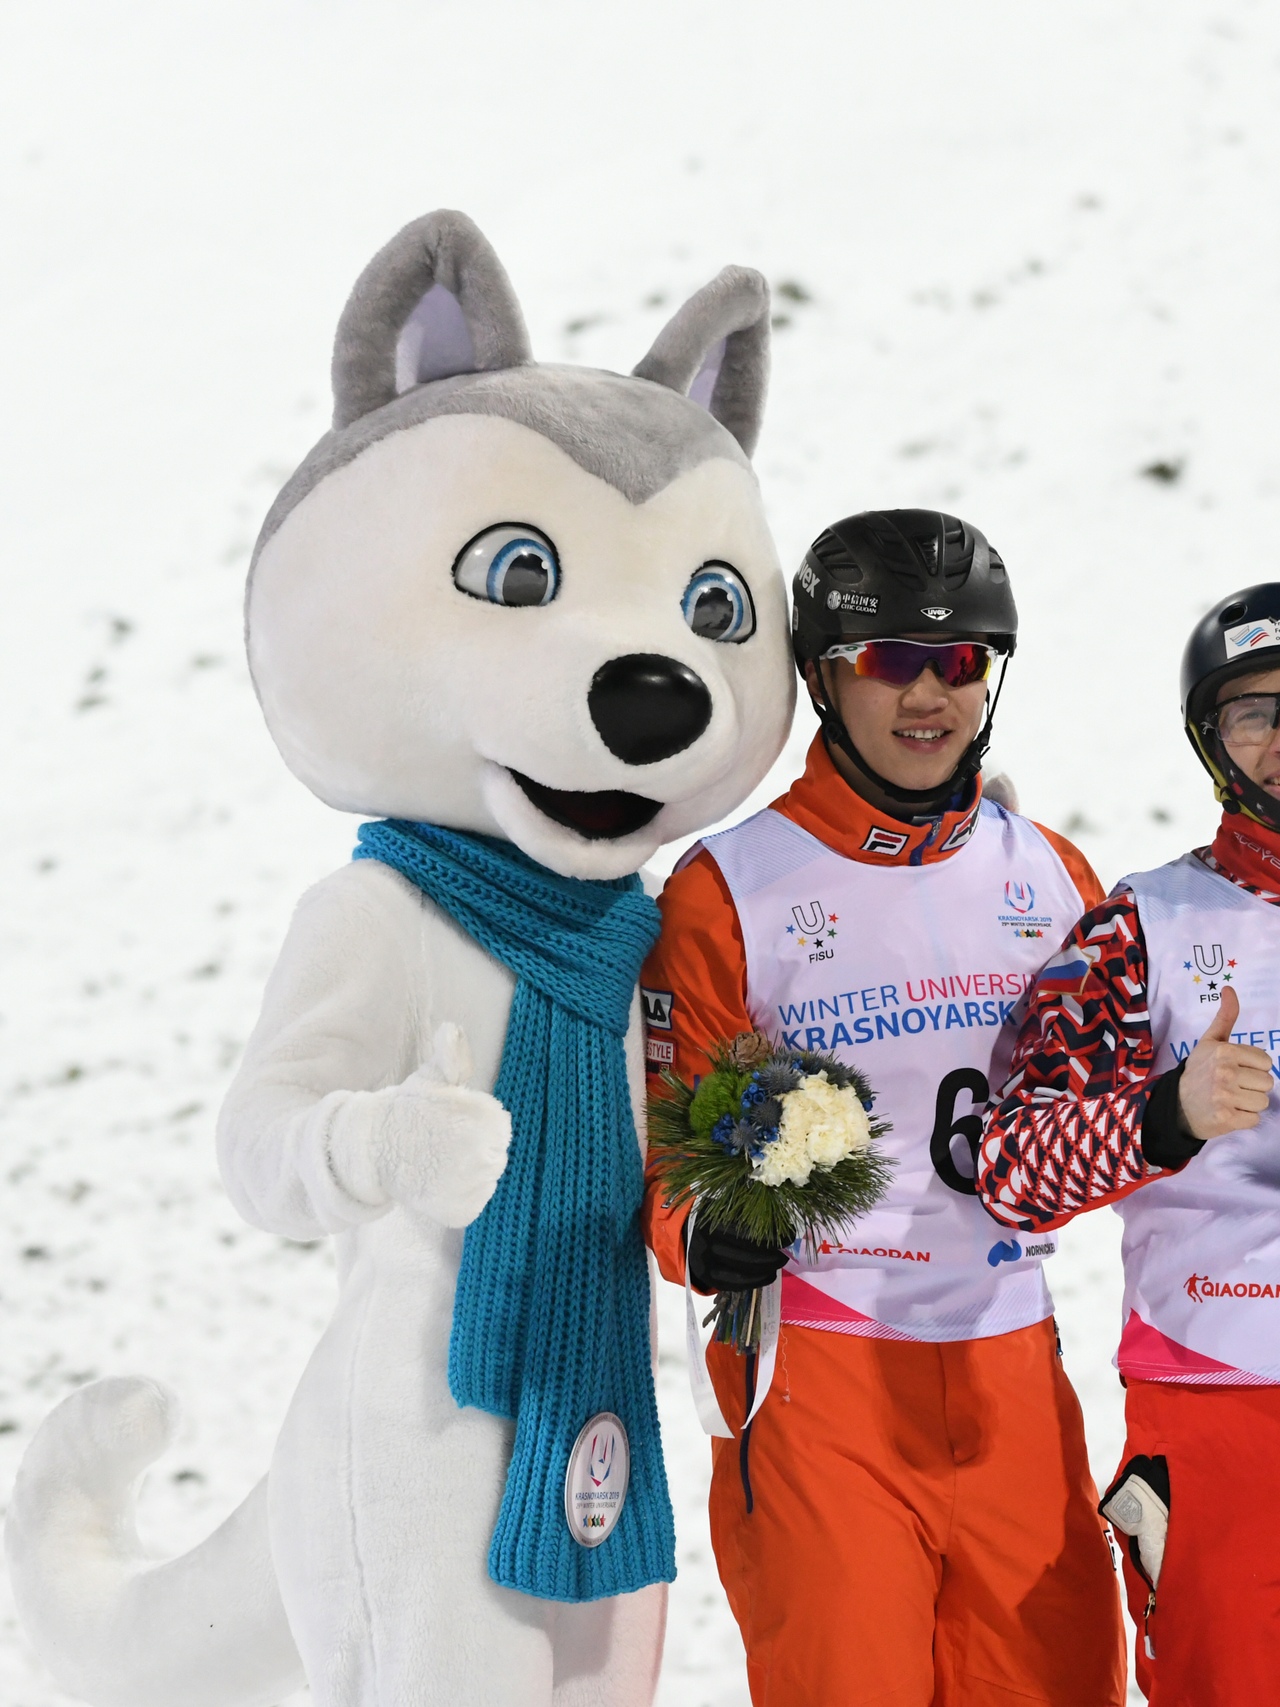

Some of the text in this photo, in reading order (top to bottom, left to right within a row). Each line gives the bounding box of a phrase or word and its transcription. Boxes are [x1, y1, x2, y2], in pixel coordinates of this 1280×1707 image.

[808, 948, 834, 964] FISU
[778, 984, 900, 1026] WINTER
[1200, 992, 1222, 1003] FIS
[782, 1000, 1018, 1052] KRASNOYARSK
[930, 1067, 990, 1196] 6
[575, 1491, 620, 1500] KRASNOYARSK 2019
